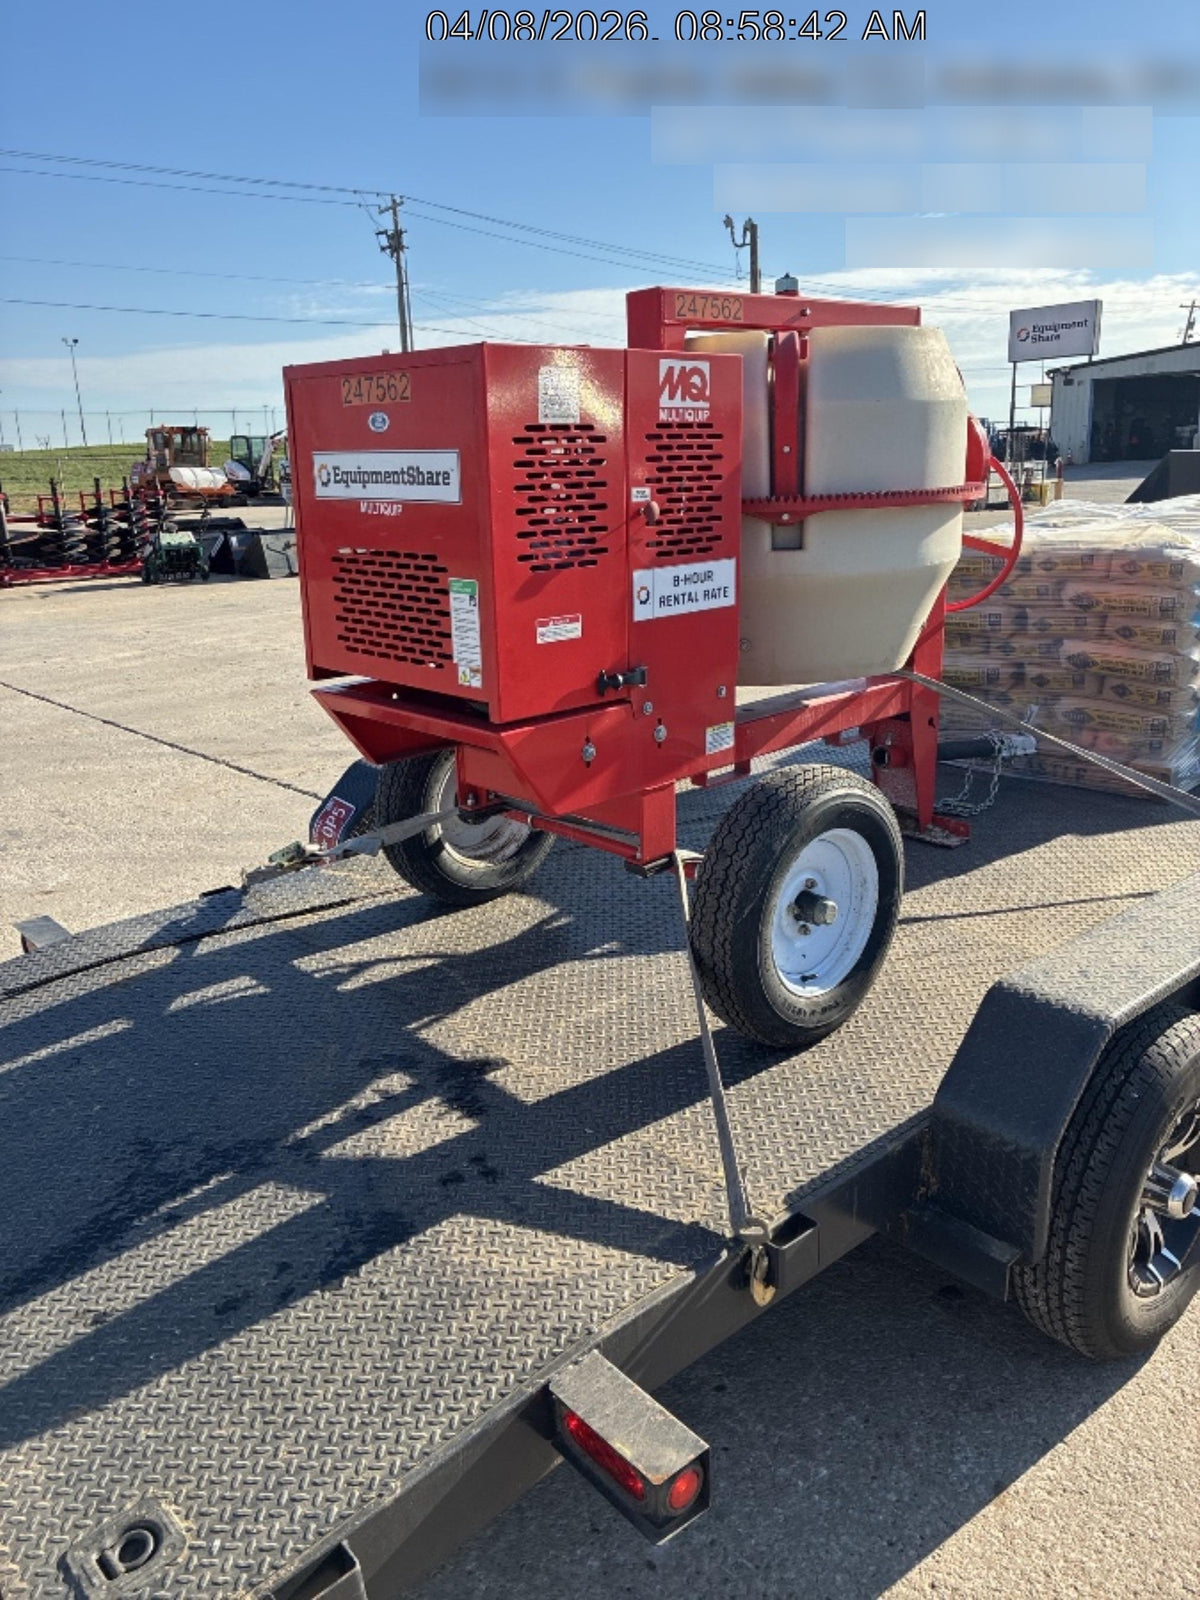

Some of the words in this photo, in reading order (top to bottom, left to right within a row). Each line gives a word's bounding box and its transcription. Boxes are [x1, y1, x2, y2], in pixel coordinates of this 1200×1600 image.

[676, 294, 743, 321] 247562
[1031, 318, 1088, 334] Equipment
[1030, 334, 1061, 344] Share
[342, 371, 411, 404] 247562
[659, 365, 709, 402] MQ
[332, 465, 451, 489] EquipmentShare
[658, 591, 700, 609] RENTAL
[703, 586, 730, 602] RATE
